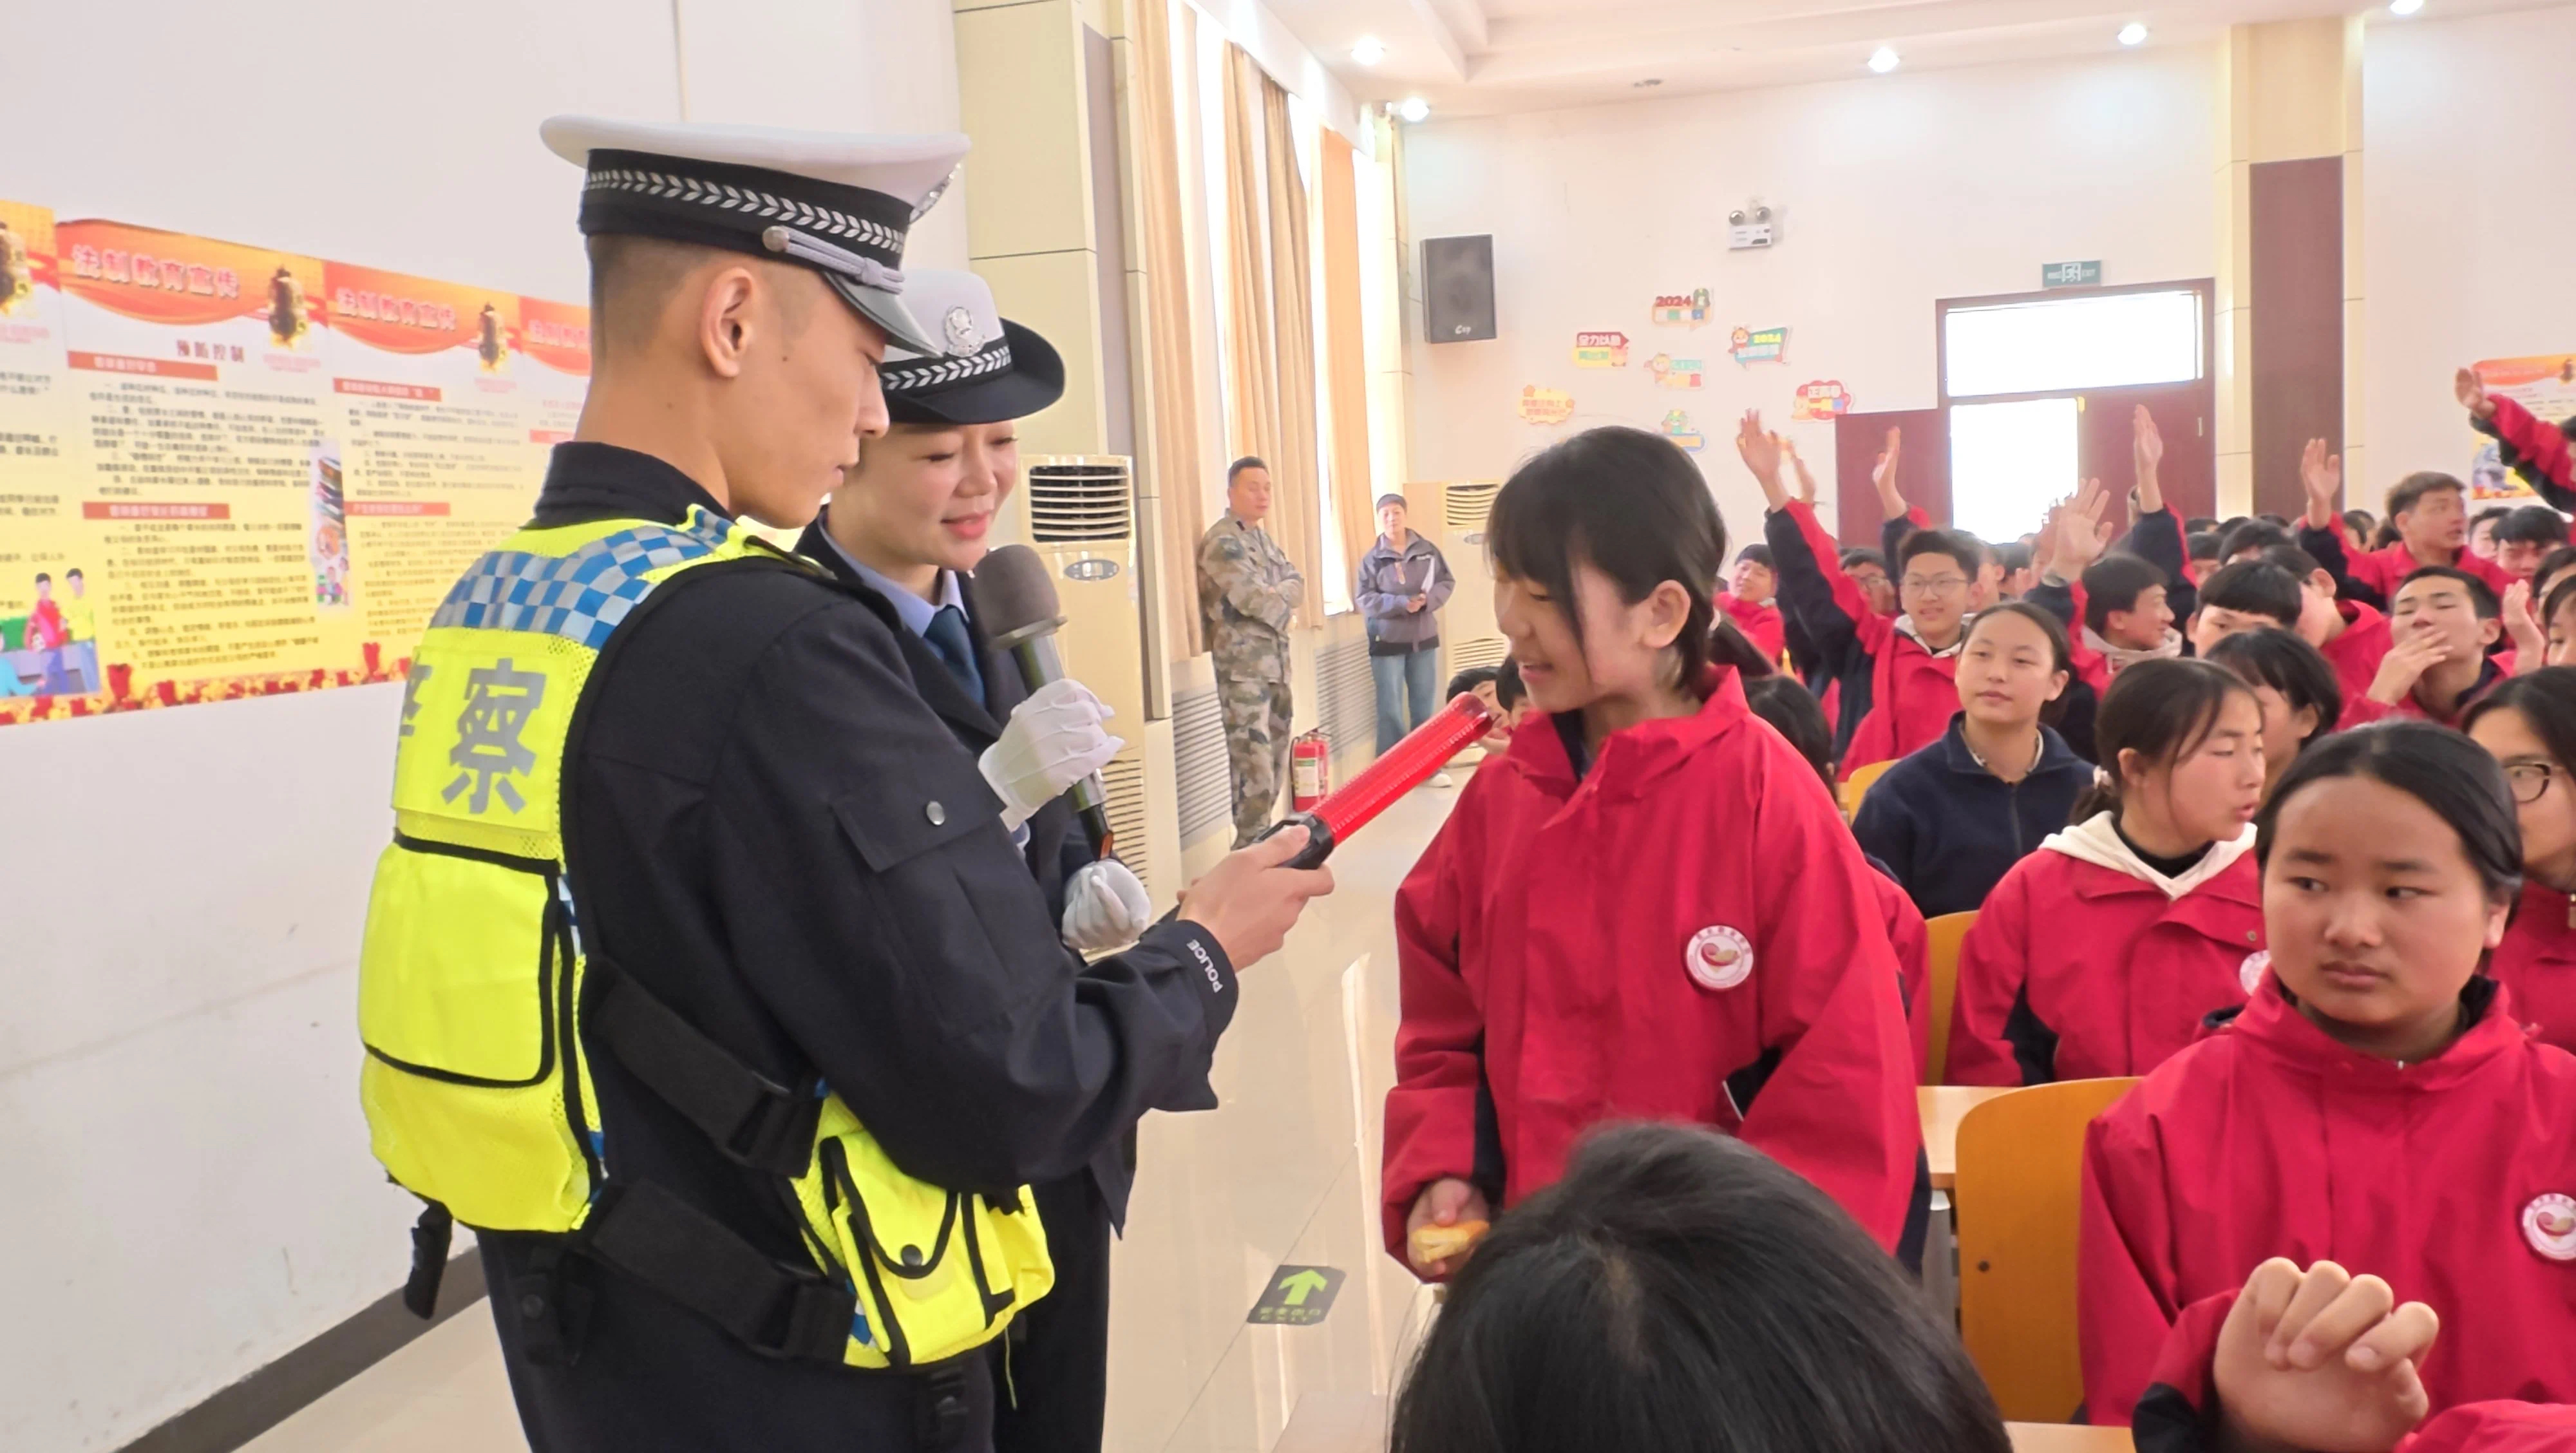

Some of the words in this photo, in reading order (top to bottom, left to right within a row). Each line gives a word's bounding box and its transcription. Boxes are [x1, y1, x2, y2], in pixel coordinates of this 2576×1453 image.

[71, 243, 240, 299] 法制教育宣传
[1656, 296, 1691, 307] 2024
[1186, 939, 1223, 993] POLICE
